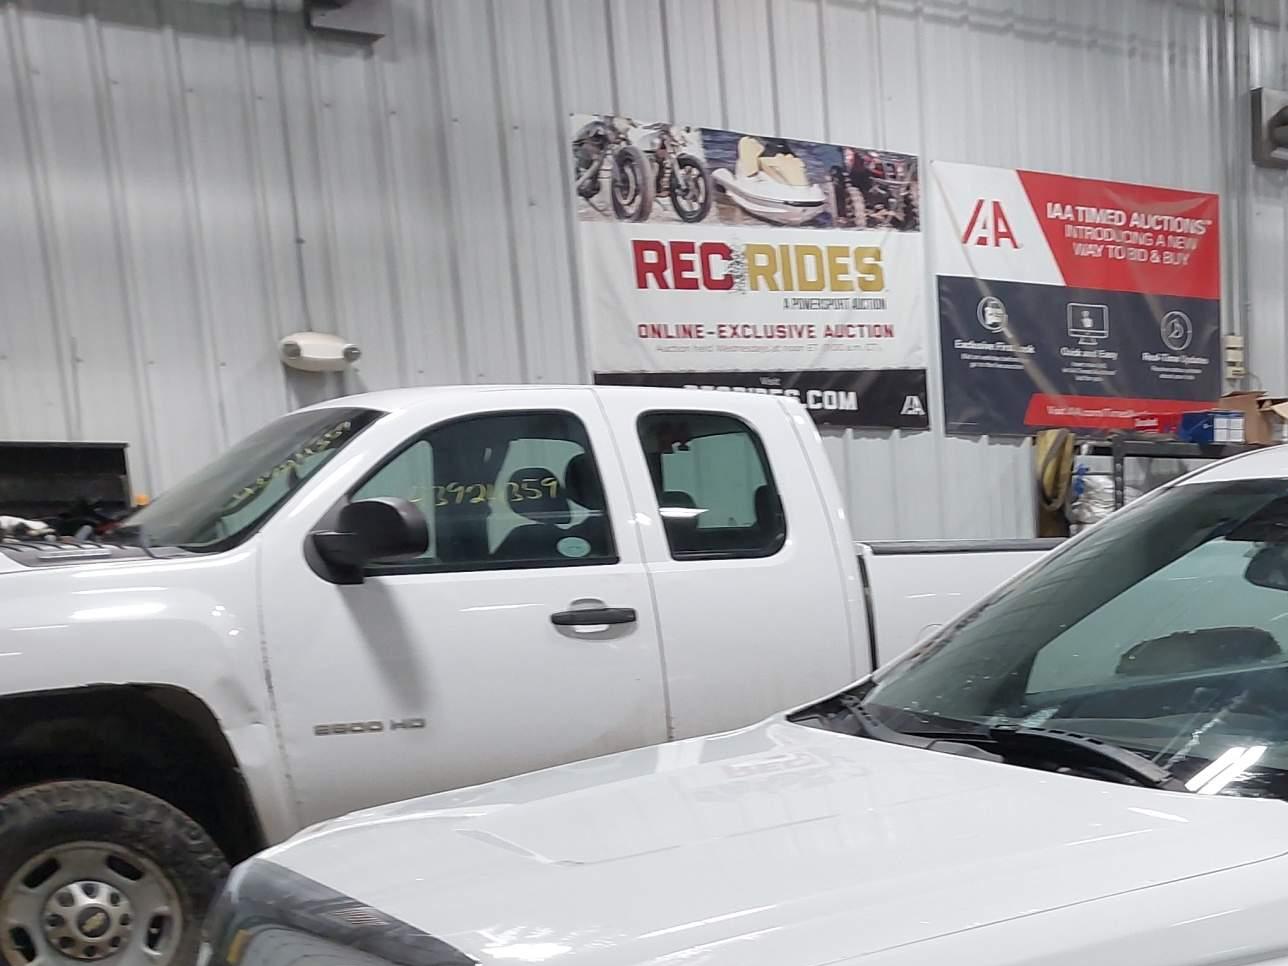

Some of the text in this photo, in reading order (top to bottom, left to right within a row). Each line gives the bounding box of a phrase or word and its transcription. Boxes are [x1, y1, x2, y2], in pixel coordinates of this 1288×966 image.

[1046, 202, 1075, 219] IAA
[1075, 206, 1126, 226] TIMED
[1065, 224, 1200, 250] INTRODUCING A NEW
[632, 239, 735, 290] REC
[747, 243, 885, 292] RIDES
[1072, 243, 1192, 266] WAY TO BID & BUY
[637, 323, 895, 340] ONLINE-EXCLUSIVE AUCTION
